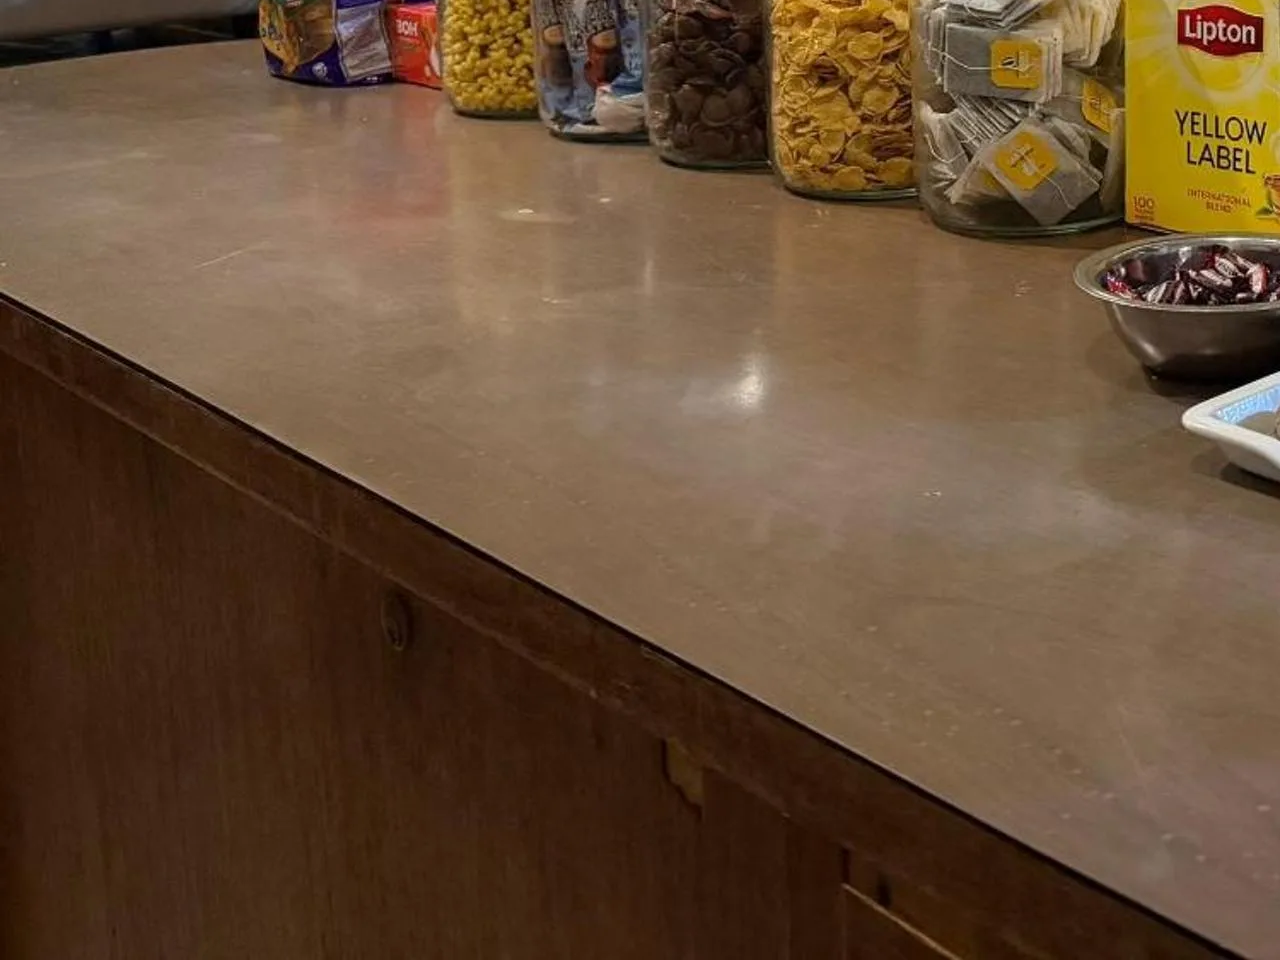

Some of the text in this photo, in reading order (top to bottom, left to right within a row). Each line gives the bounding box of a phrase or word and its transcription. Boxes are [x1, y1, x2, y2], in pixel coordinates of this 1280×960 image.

[1184, 14, 1257, 46] Lipton
[1174, 108, 1268, 146] YELLOW
[1187, 141, 1257, 175] LABEL
[1133, 196, 1155, 210] 100
